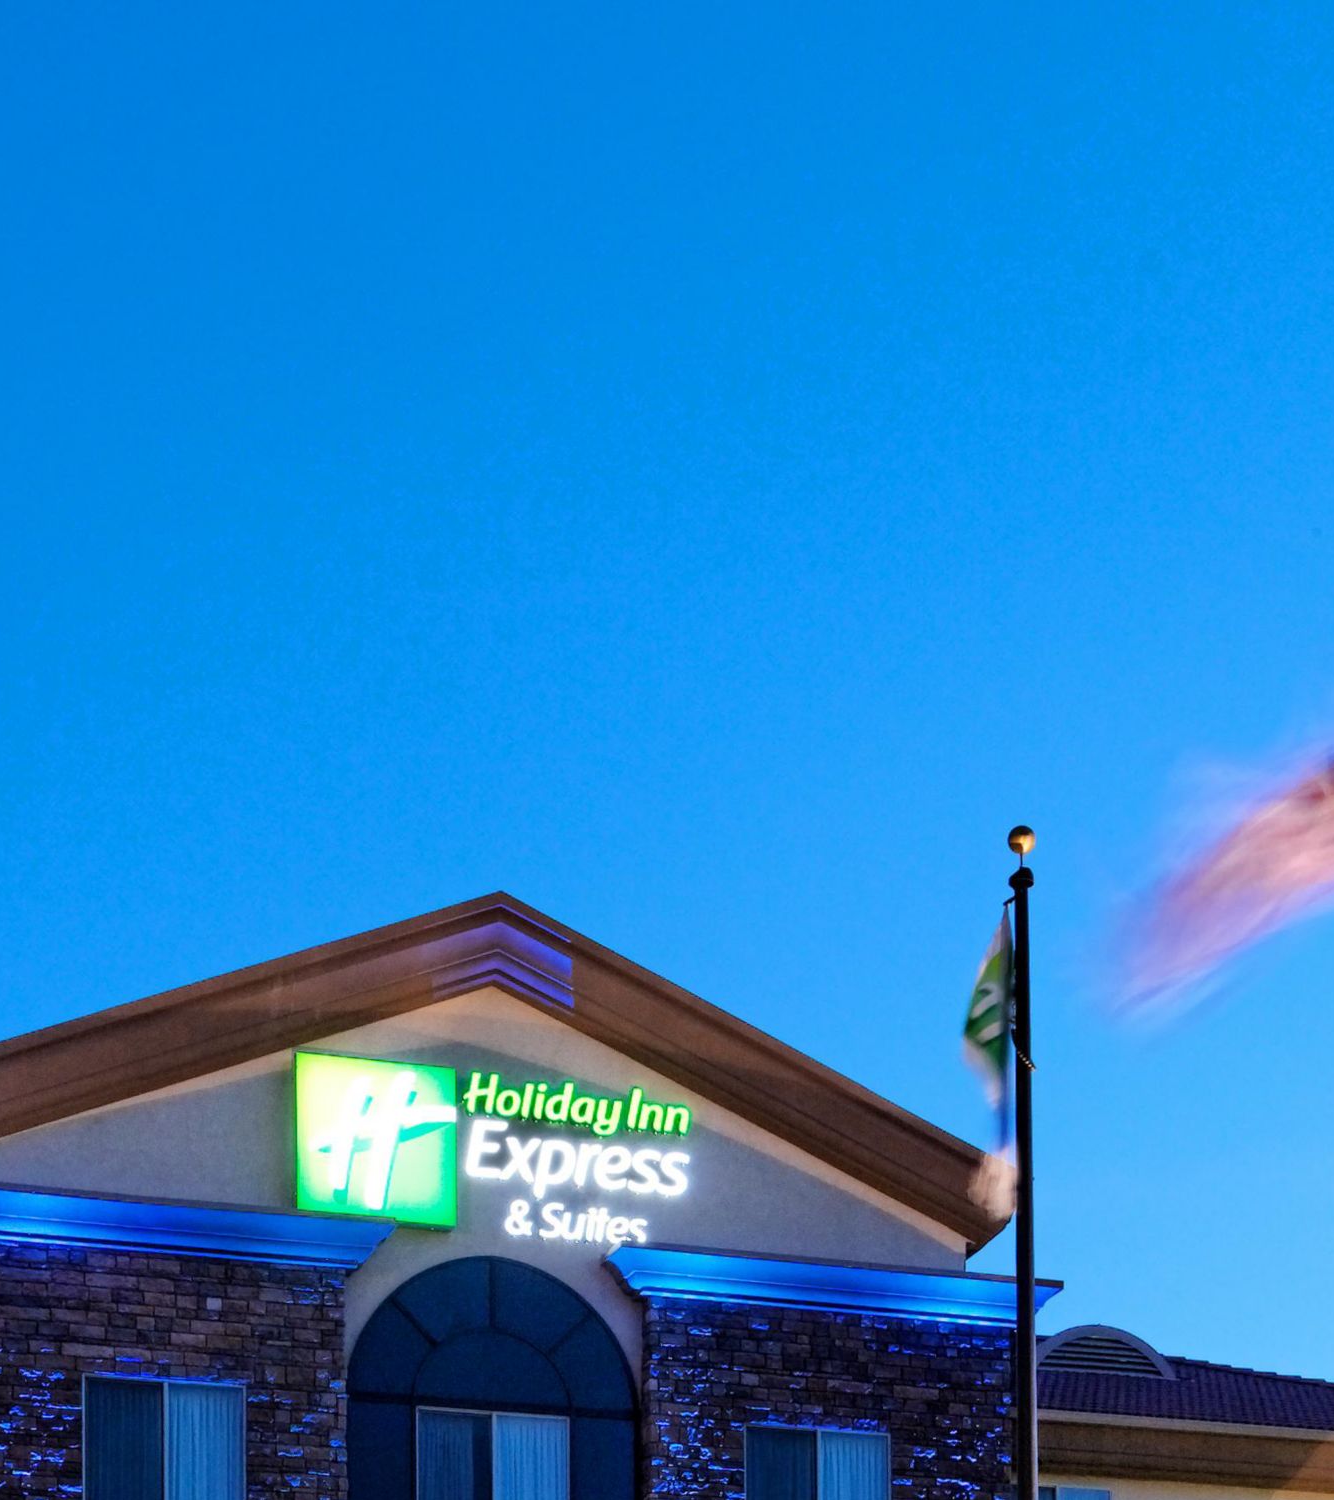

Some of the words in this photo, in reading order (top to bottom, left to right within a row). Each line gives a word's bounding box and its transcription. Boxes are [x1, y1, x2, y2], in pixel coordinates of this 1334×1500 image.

[463, 1071, 623, 1136] Holiday
[627, 1087, 691, 1135] Inn
[465, 1118, 692, 1199] Express
[504, 1199, 533, 1236] &
[539, 1202, 648, 1243] Suites
